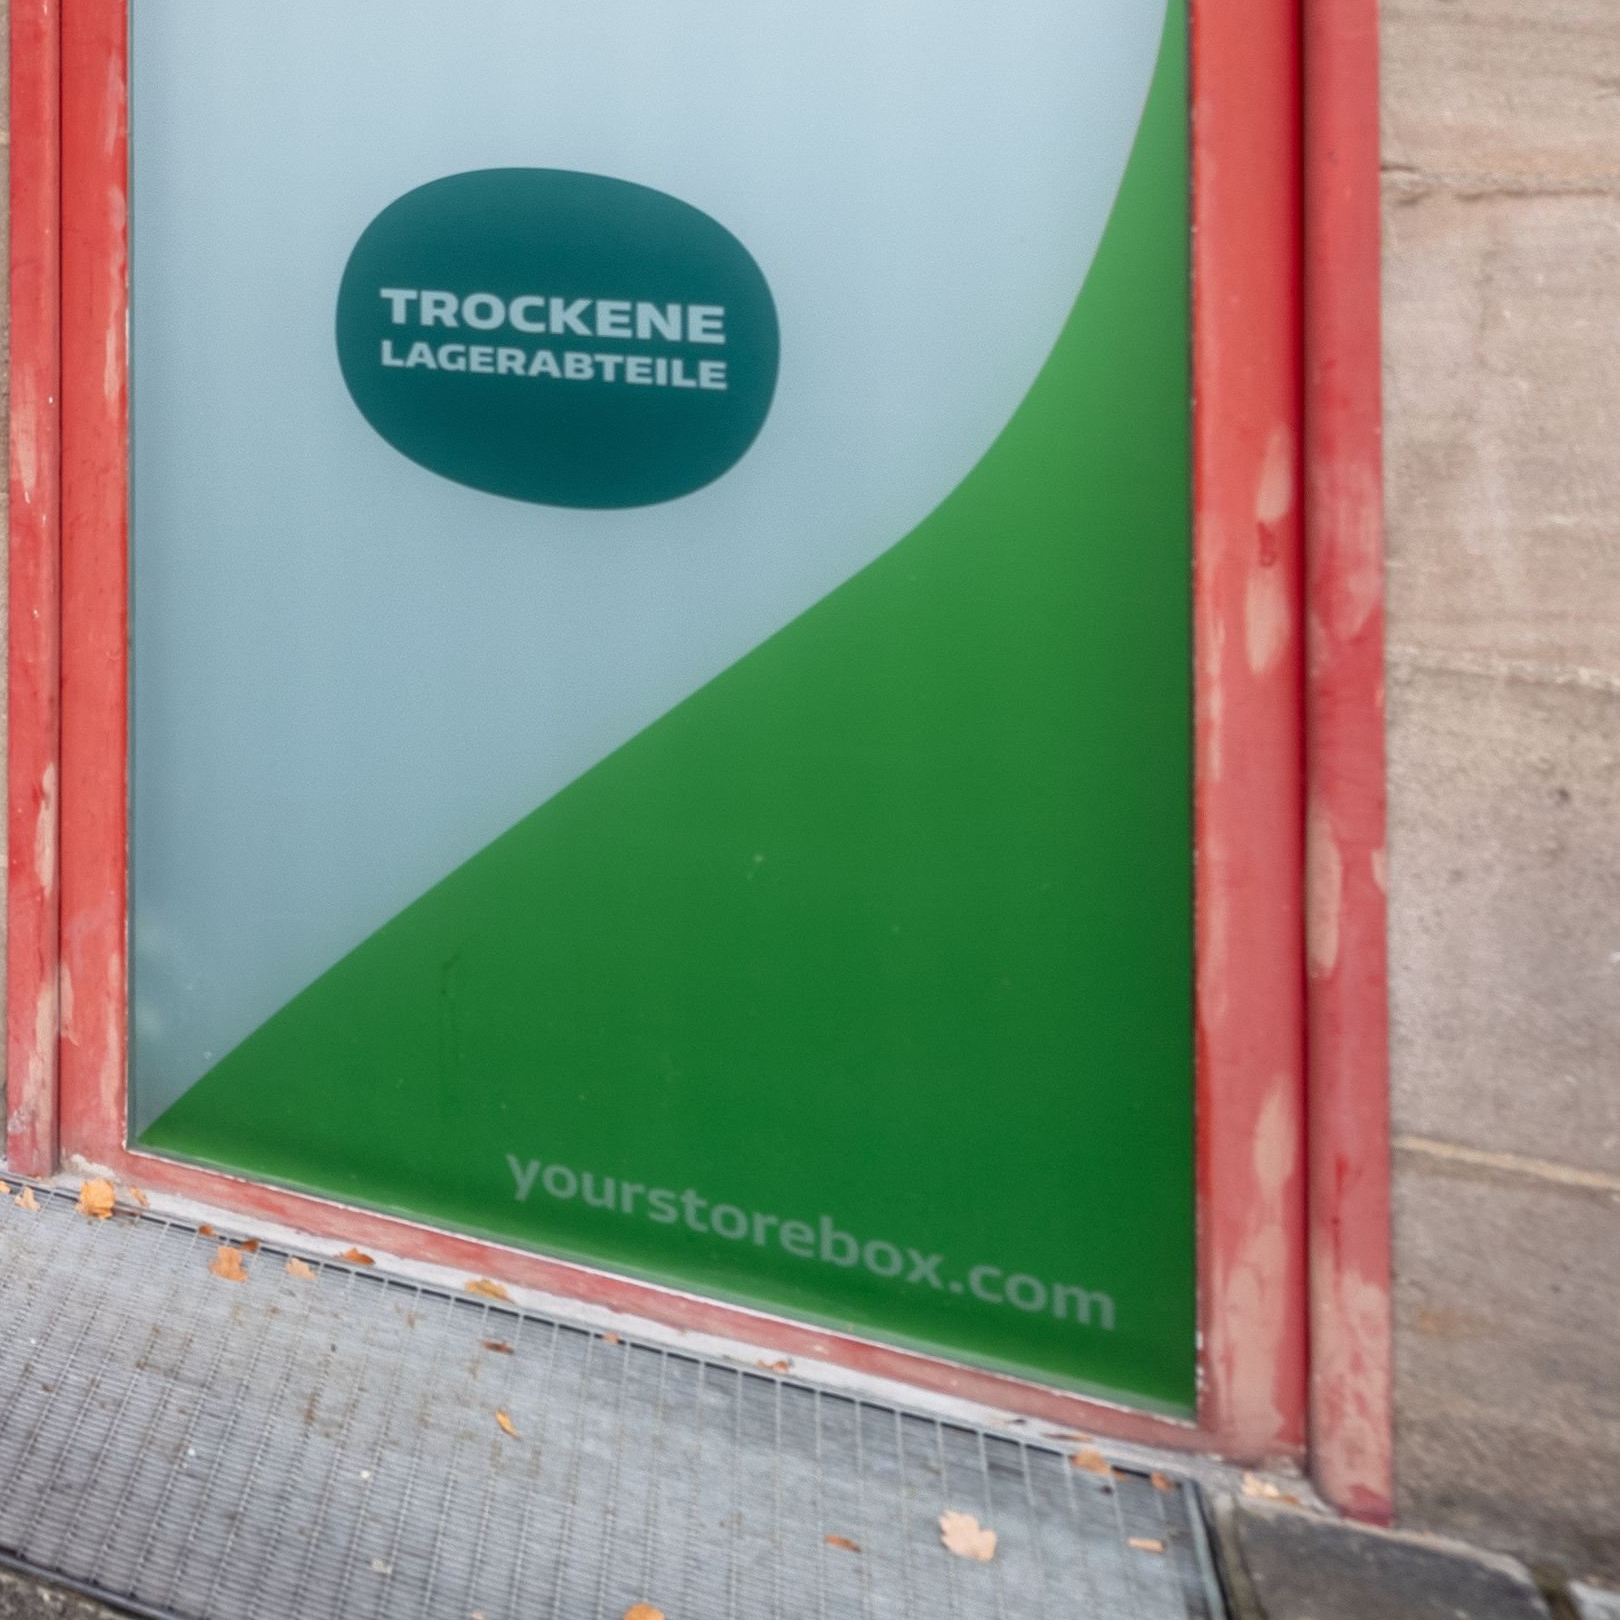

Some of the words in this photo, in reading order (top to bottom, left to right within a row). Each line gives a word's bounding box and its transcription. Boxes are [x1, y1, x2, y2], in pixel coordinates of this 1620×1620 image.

[380, 285, 726, 345] TROCKENE
[380, 338, 728, 390] LAGERABTEILE
[505, 1153, 1117, 1332] yourstorebox.com
